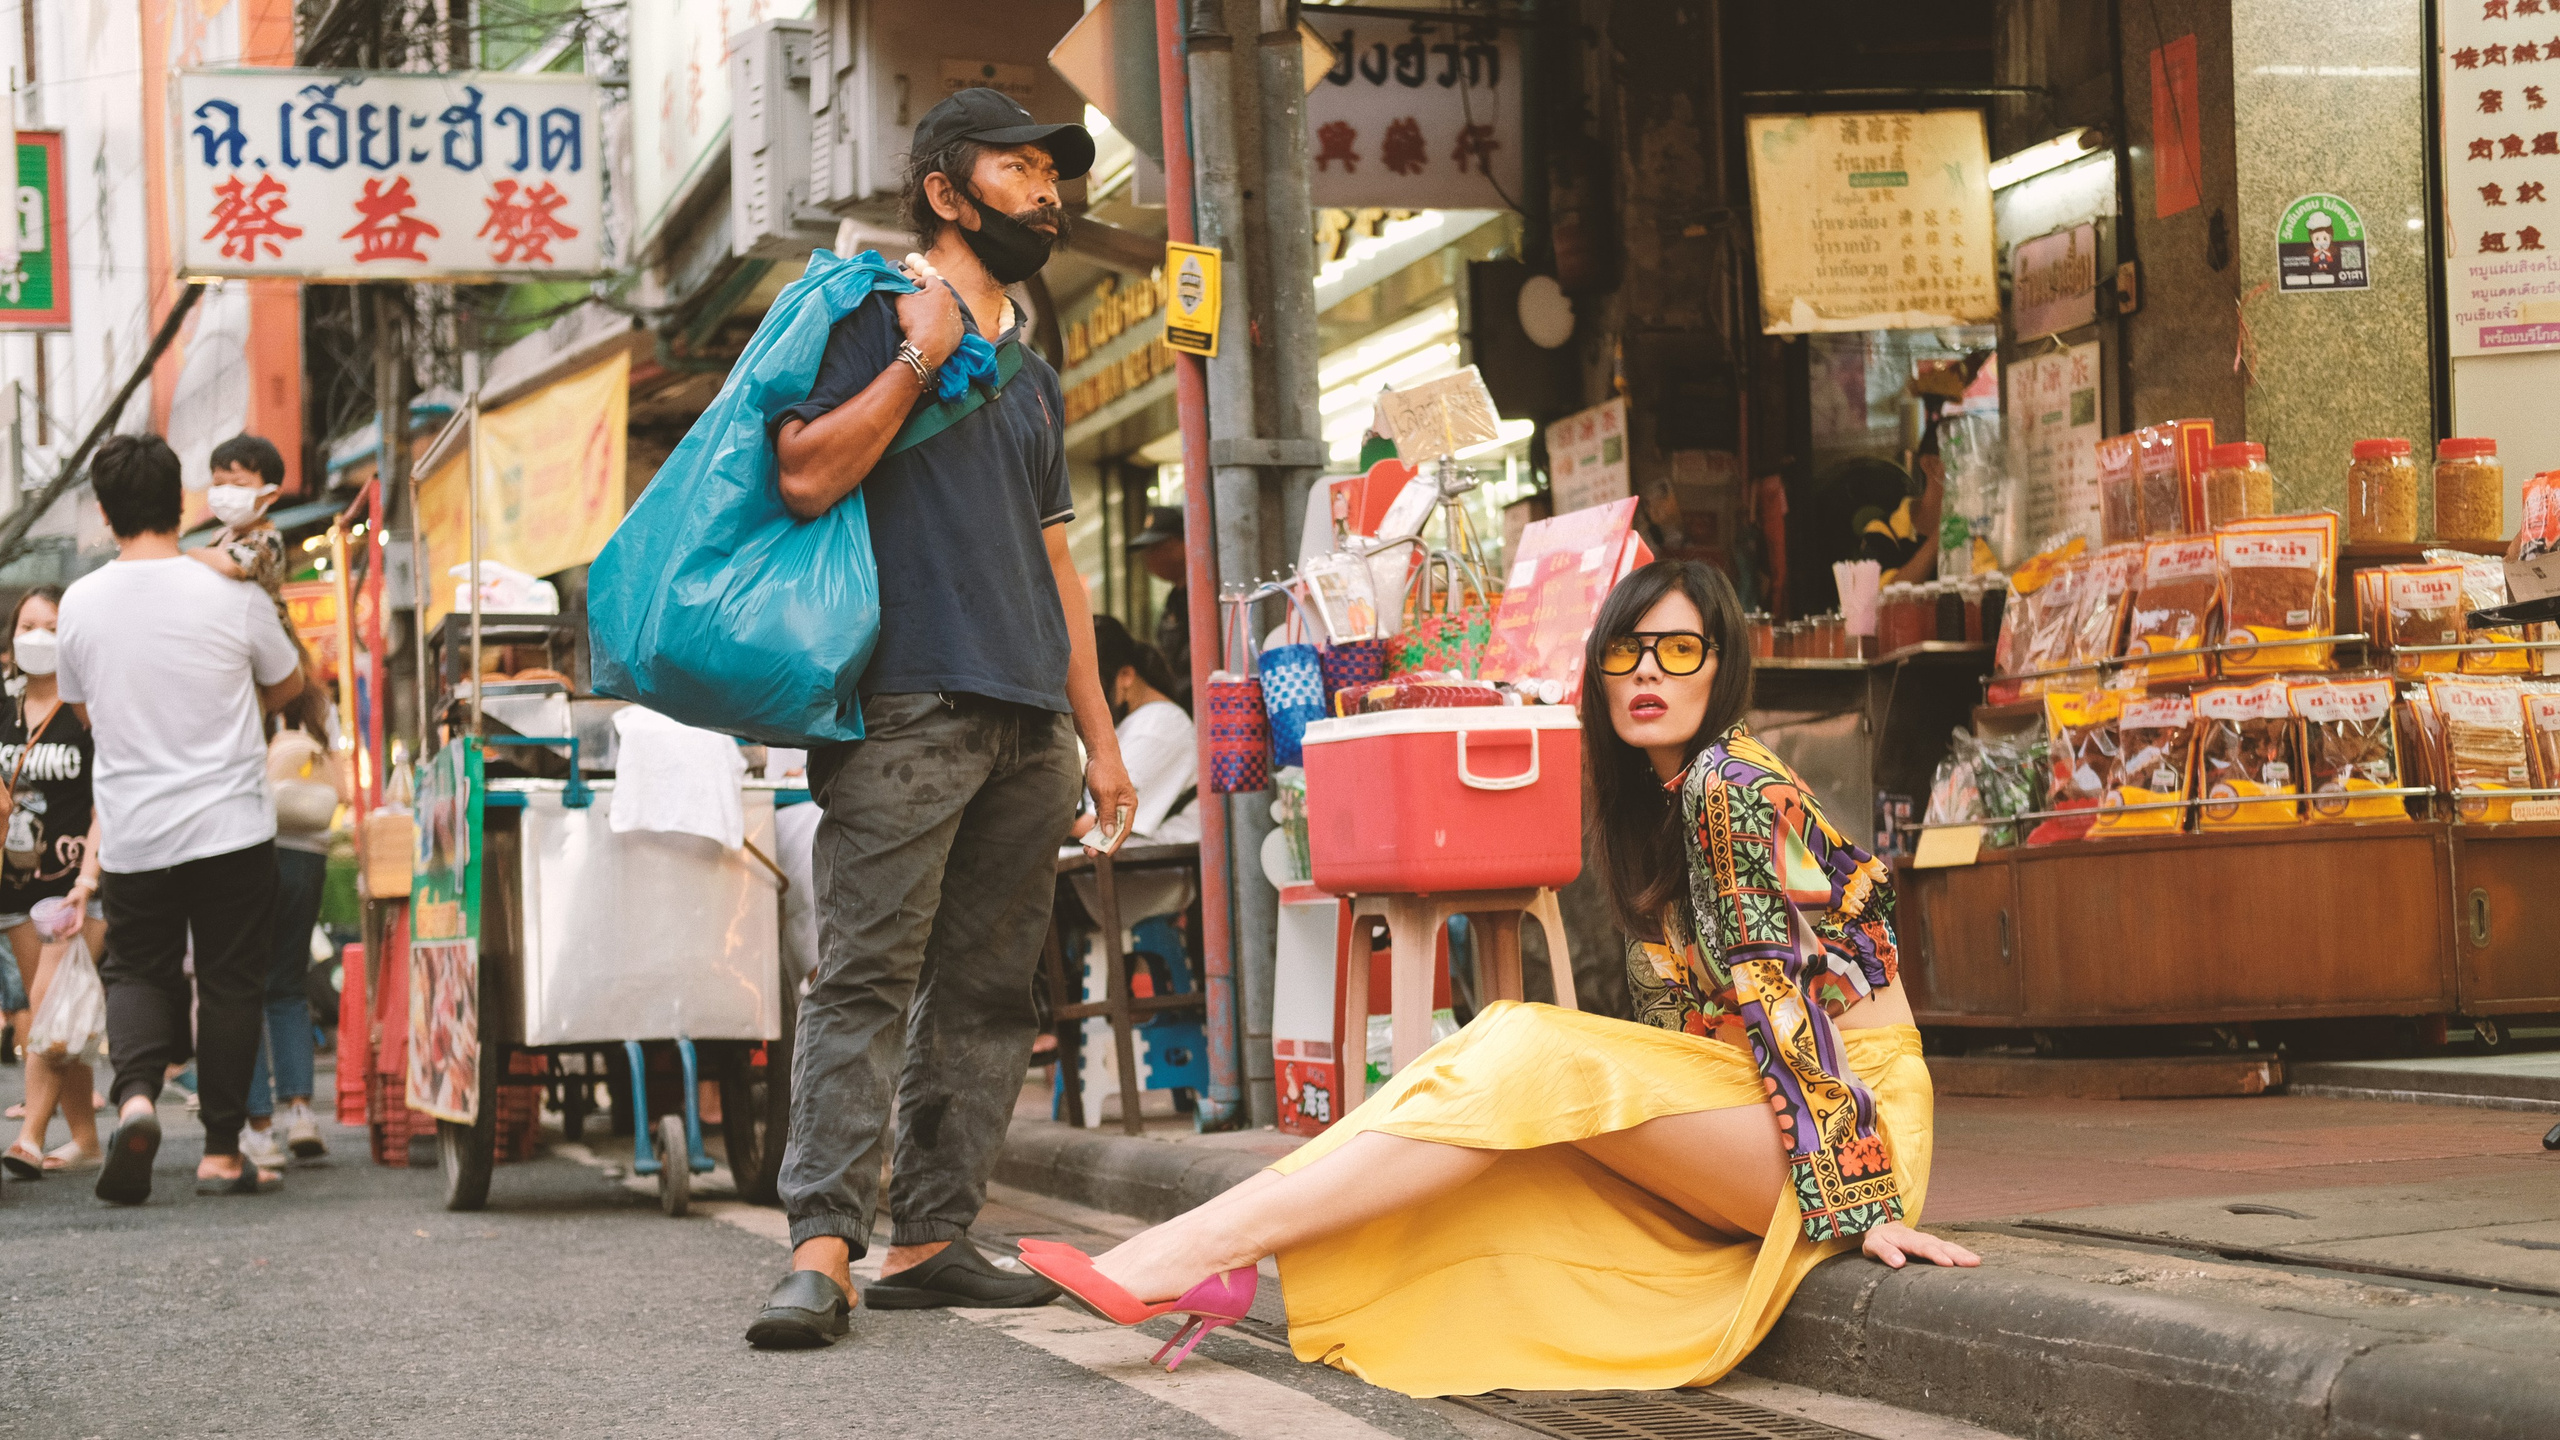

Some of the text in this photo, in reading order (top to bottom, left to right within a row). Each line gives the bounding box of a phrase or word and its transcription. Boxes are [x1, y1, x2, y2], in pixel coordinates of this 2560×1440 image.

[203, 174, 579, 264] 蔡益發
[0, 742, 81, 781] SCHINO
